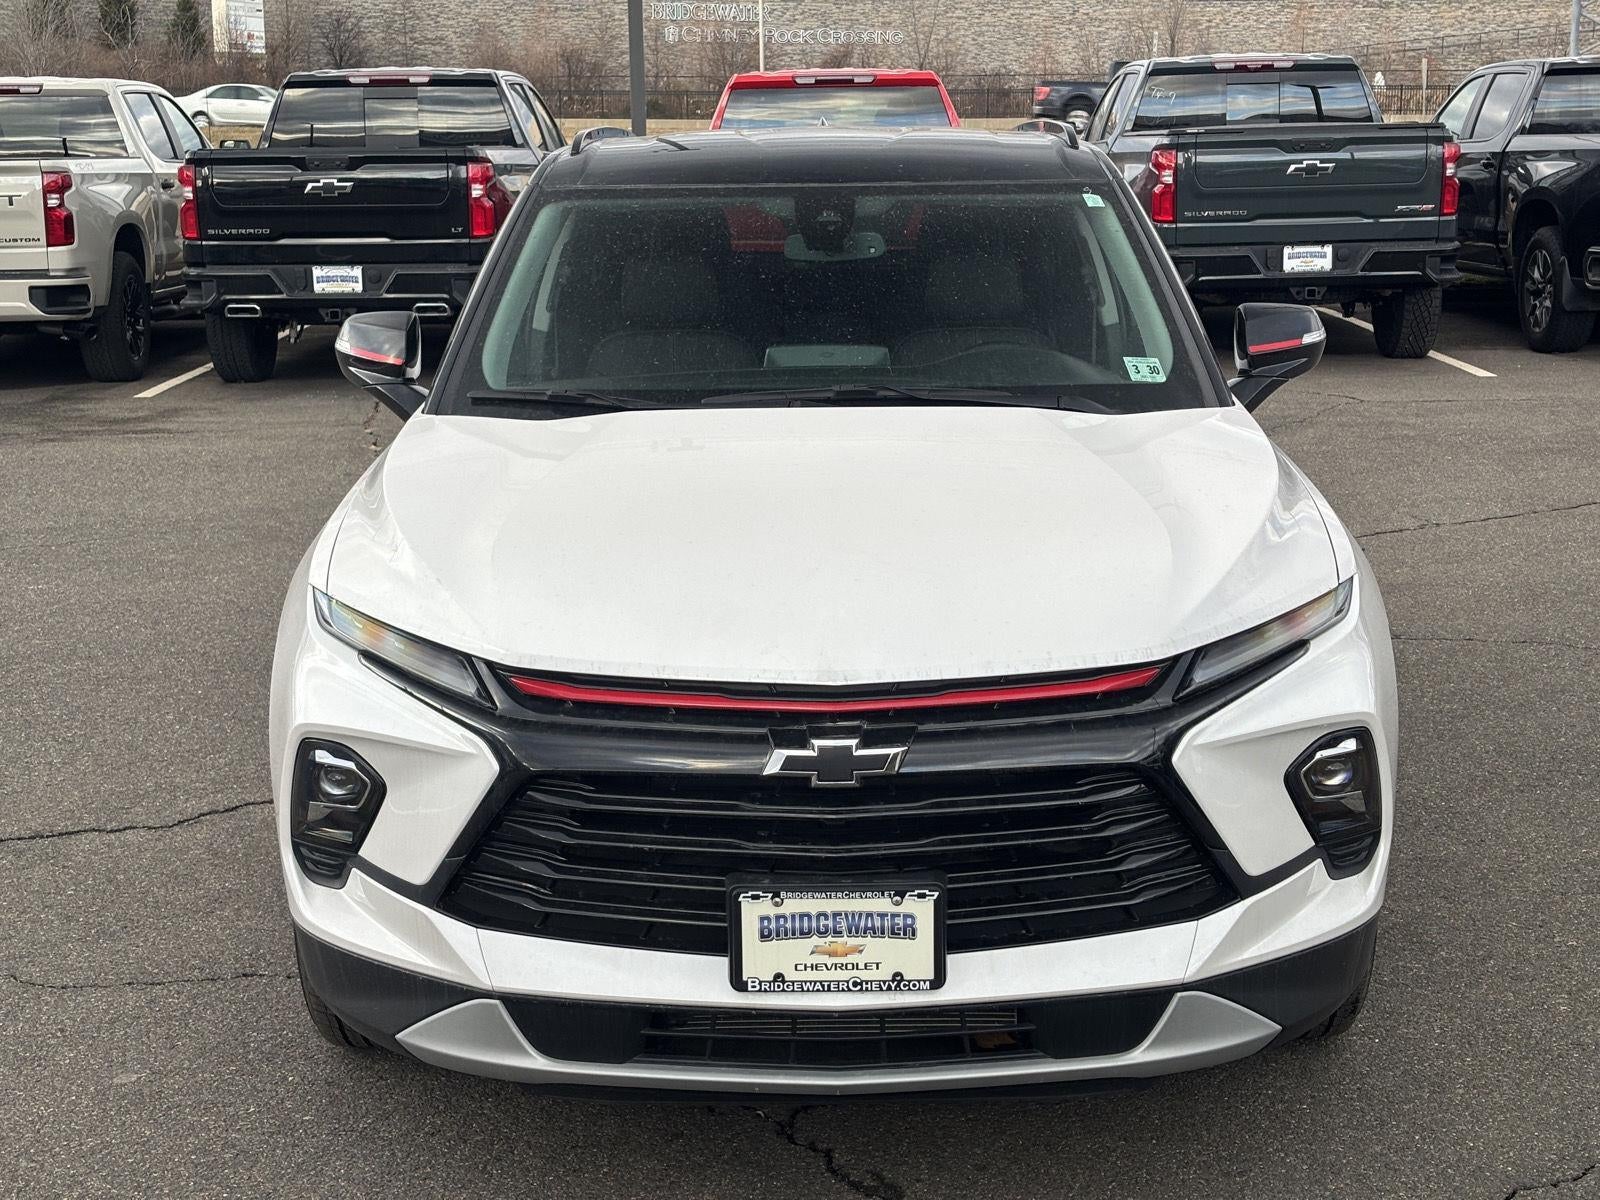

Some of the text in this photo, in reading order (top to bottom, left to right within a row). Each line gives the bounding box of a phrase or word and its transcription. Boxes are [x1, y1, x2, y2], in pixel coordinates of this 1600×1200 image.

[650, 3, 772, 21] BRIDGEWATER
[682, 26, 904, 45] CHIMNEY ROCK CROSSING
[1131, 364, 1160, 376] 3 30
[780, 891, 896, 900] BRIDGEWATERCHEVROLET
[758, 911, 918, 942] BRIDGEWATER
[794, 961, 882, 972] CHEVROLET
[747, 977, 931, 992] BRIDGEWATERCHEVY.COM
